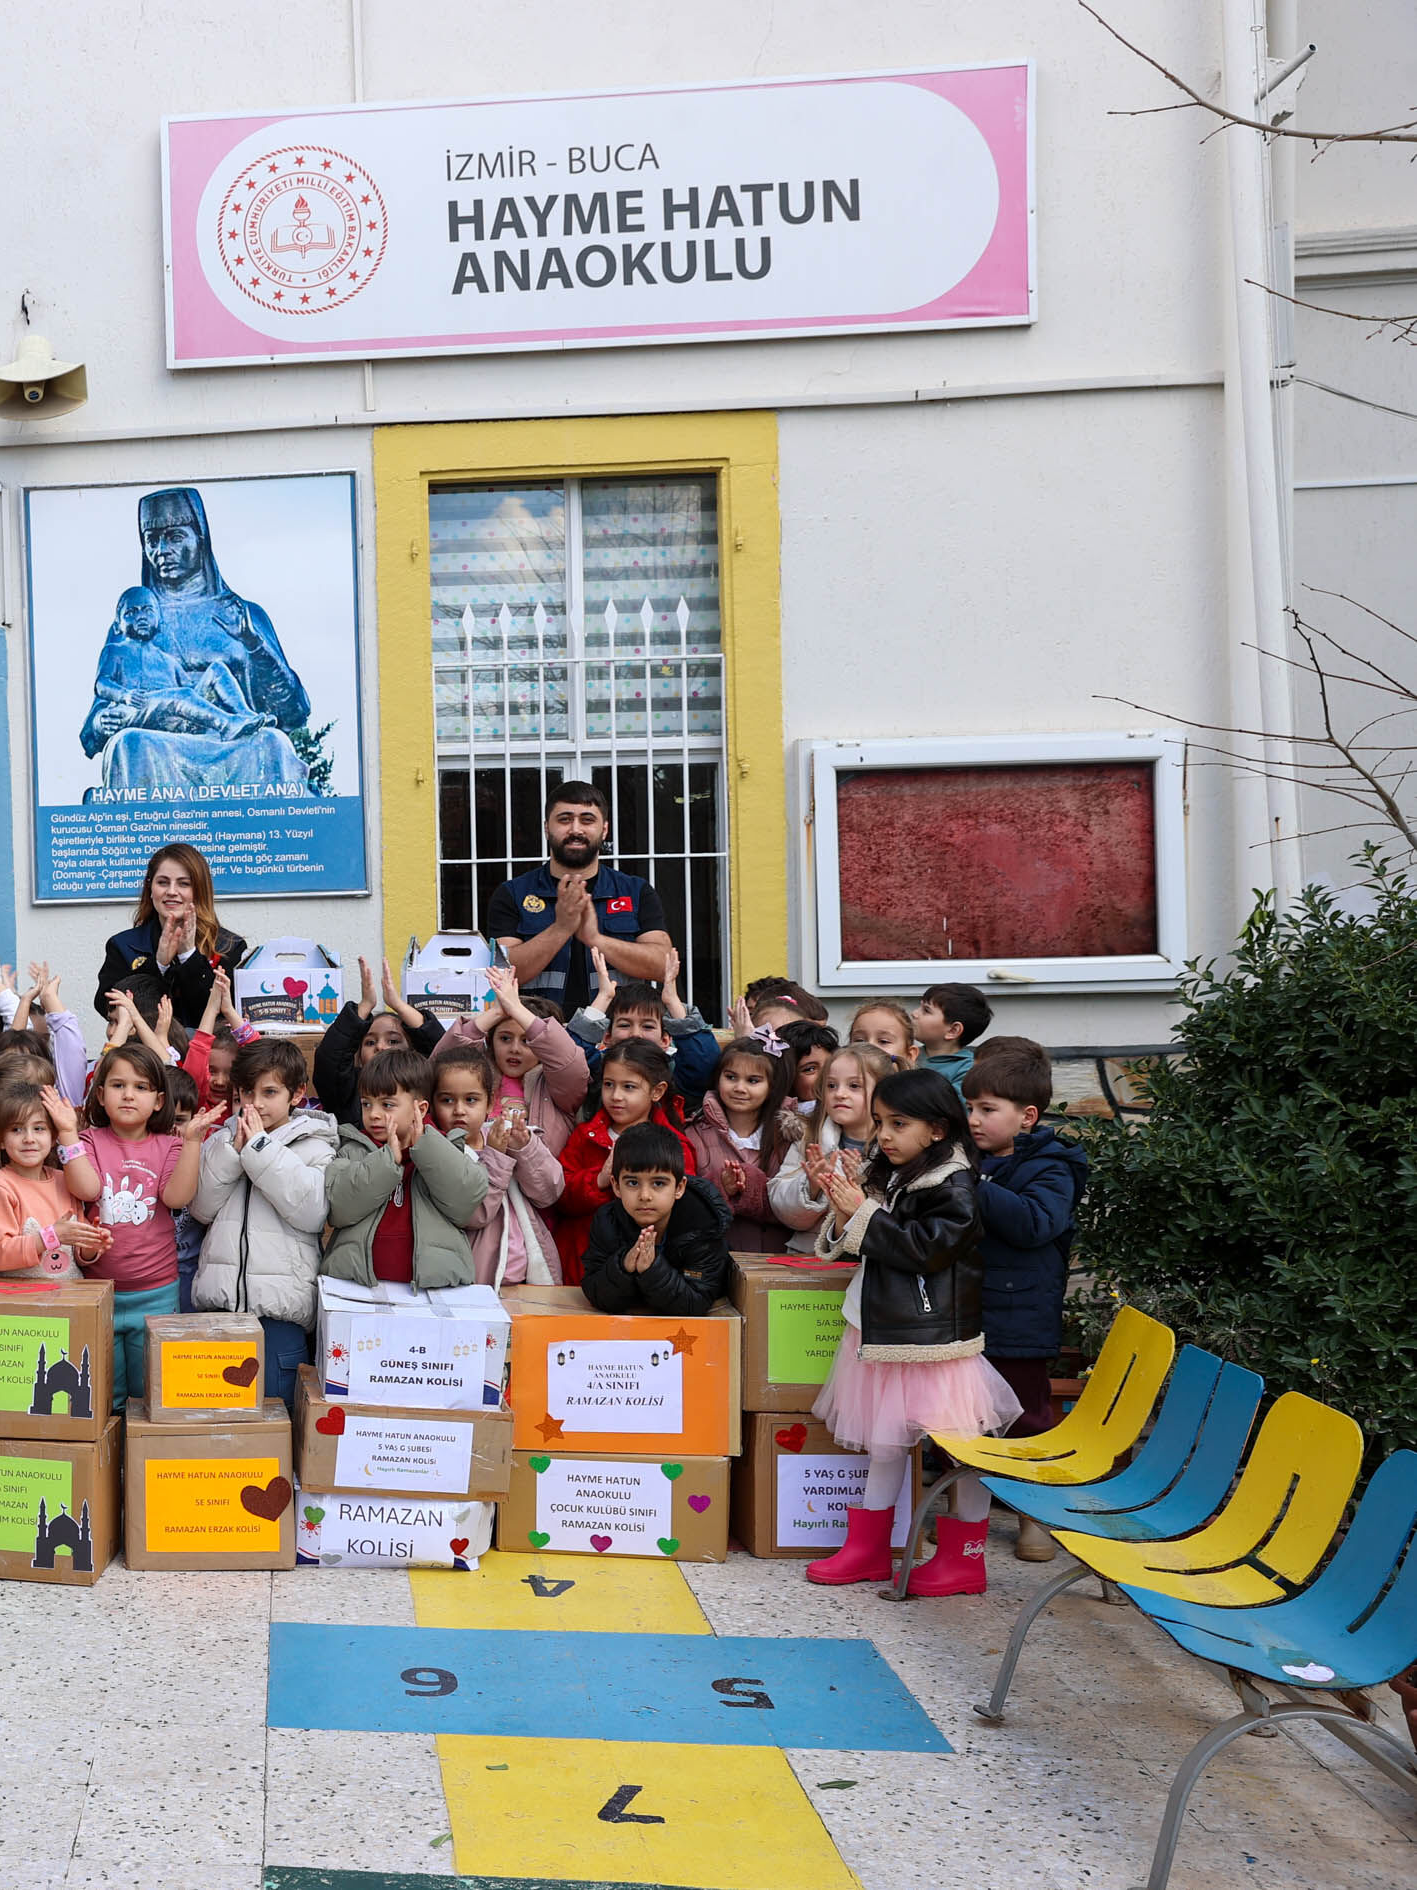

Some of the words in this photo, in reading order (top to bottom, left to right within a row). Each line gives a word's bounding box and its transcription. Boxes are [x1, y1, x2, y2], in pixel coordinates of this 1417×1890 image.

[445, 145, 536, 182] İZMİR
[568, 142, 660, 173] BUCA
[296, 177, 329, 189] MİLLİ
[328, 186, 356, 222] EĞİTİM
[447, 189, 646, 243] HAYME
[662, 178, 862, 232] HATUN
[248, 178, 294, 245] CUMHURİYETİ
[317, 226, 357, 280] BAKANLIĞI
[252, 248, 294, 283] TÜRKİYE
[451, 237, 774, 295] ANAOKULU
[92, 787, 147, 802] HAYME
[151, 786, 185, 800] ANA
[198, 784, 260, 799] DEVLET
[264, 782, 303, 798] ANA)
[51, 813, 86, 823] Gündüz
[134, 810, 170, 822] Ertuğrul
[211, 808, 245, 819] annesi,
[247, 806, 286, 817] Osmanlı
[287, 805, 335, 816] Devleti'nin
[51, 825, 92, 834] kurucusu
[95, 823, 128, 833] Osman
[169, 820, 209, 831] ninesidir.
[51, 835, 104, 847] Aşiretleriyle
[106, 834, 135, 843] birlikte
[138, 833, 161, 843] önce
[163, 831, 213, 843] Karacadağ
[215, 830, 267, 843] (Haymana)
[269, 830, 283, 840] 13.
[285, 829, 314, 841] Yüzyıl
[52, 847, 99, 858] başlarında
[102, 845, 128, 857] Söğüt
[131, 846, 142, 855] ve
[228, 842, 268, 854] gelmiştir.
[52, 859, 77, 869] Yayla
[79, 857, 107, 867] olarak
[255, 854, 272, 864] göç
[275, 853, 309, 862] zamanı
[52, 870, 97, 881] (Domaniç
[230, 865, 243, 874] Ve
[245, 863, 285, 875] bugünkü
[287, 863, 324, 873] türbenin
[52, 881, 84, 892] olduğu
[86, 881, 107, 892] yere
[780, 1304, 811, 1312] HAYME
[813, 1304, 844, 1312] HATUN
[816, 1319, 831, 1327] 5/A
[11, 1329, 60, 1338] ANAOKULU
[409, 1346, 427, 1355] 4-B
[380, 1358, 418, 1370] GÜNEŞ
[421, 1361, 454, 1371] SINIFI
[587, 1364, 618, 1372] HAYME
[618, 1364, 645, 1372] HATUN
[369, 1375, 423, 1386] RAMAZAN
[427, 1375, 463, 1387] KOLİSİ
[586, 1381, 603, 1390] 4/A
[605, 1381, 640, 1390] SINIFI
[566, 1396, 622, 1406] RAMAZAN
[626, 1395, 665, 1407] KOLİSİ
[356, 1430, 383, 1439] HAYME
[385, 1432, 412, 1440] HATUN
[413, 1433, 456, 1443] ANAOKULU
[372, 1455, 411, 1464] RAMAZAN
[15, 1470, 62, 1481] ANAOKULU
[156, 1471, 186, 1480] HAYME
[188, 1472, 217, 1480] HATUN
[218, 1471, 264, 1480] ANAOKULU
[567, 1474, 602, 1484] HAYME
[605, 1476, 641, 1486] HATUN
[804, 1469, 811, 1478] 5
[814, 1469, 834, 1480] YAŞ
[837, 1469, 846, 1478] G
[3, 1485, 28, 1494] SINIFI
[575, 1489, 631, 1500] ANAOKULU
[338, 1503, 443, 1527] RAMAZAN
[550, 1503, 583, 1514] ÇOCUK
[586, 1504, 627, 1516] KULÜBÜ
[629, 1508, 657, 1518] SINIFI
[164, 1526, 207, 1534] RAMAZAN
[208, 1526, 234, 1534] ERZAK
[236, 1524, 261, 1533] KOLİSİ
[561, 1519, 612, 1531] RAMAZAN
[614, 1520, 645, 1532] KOLİSİ
[793, 1519, 828, 1531] Hayırlı
[347, 1537, 413, 1558] KOLİSİ
